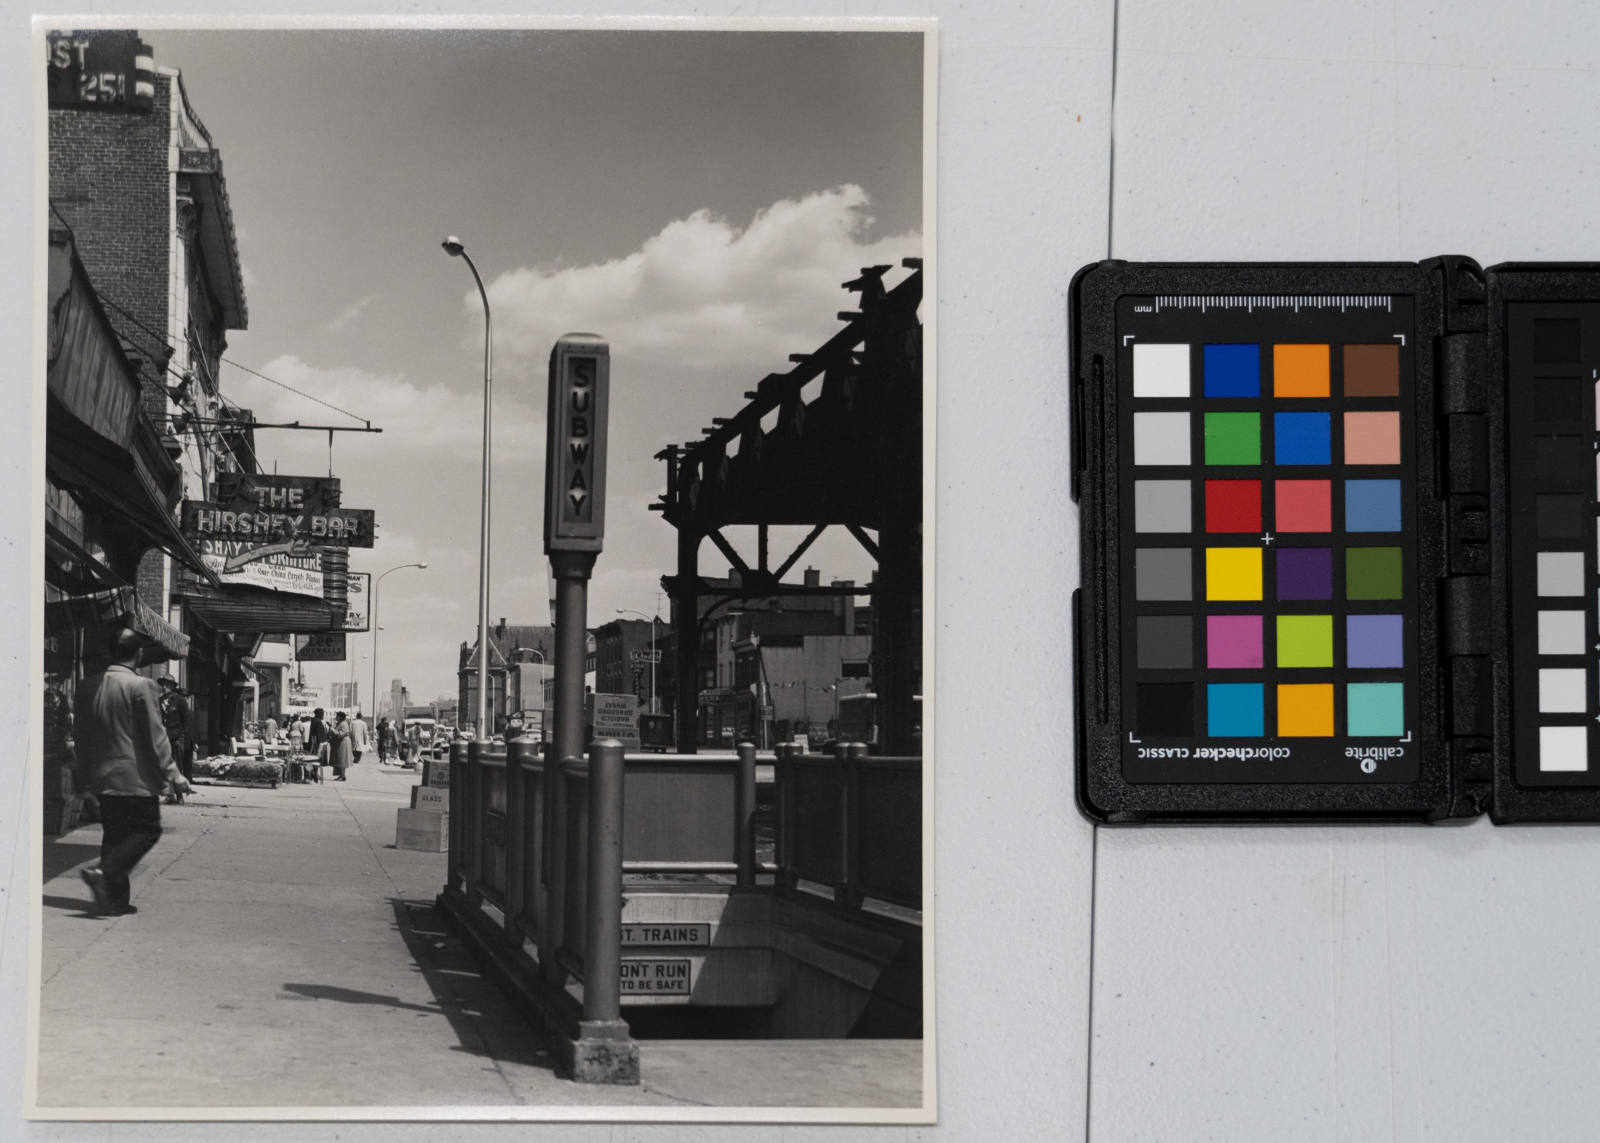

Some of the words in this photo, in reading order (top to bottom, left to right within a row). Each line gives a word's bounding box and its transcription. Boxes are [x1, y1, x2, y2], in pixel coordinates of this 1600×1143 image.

[1134, 305, 1152, 313] mm
[569, 365, 590, 516] SUBWAY
[255, 487, 305, 509] THE
[197, 509, 304, 537] HIRSHEY
[311, 515, 360, 538] BAR
[1137, 747, 1190, 759] CLASSIC
[1193, 747, 1291, 762] colorchecker
[1345, 747, 1404, 761] calibrite
[642, 928, 698, 942] TRAINS
[656, 964, 687, 978] RUN
[621, 980, 634, 990] TO
[638, 980, 653, 990] BE
[656, 980, 684, 990] SAFE
